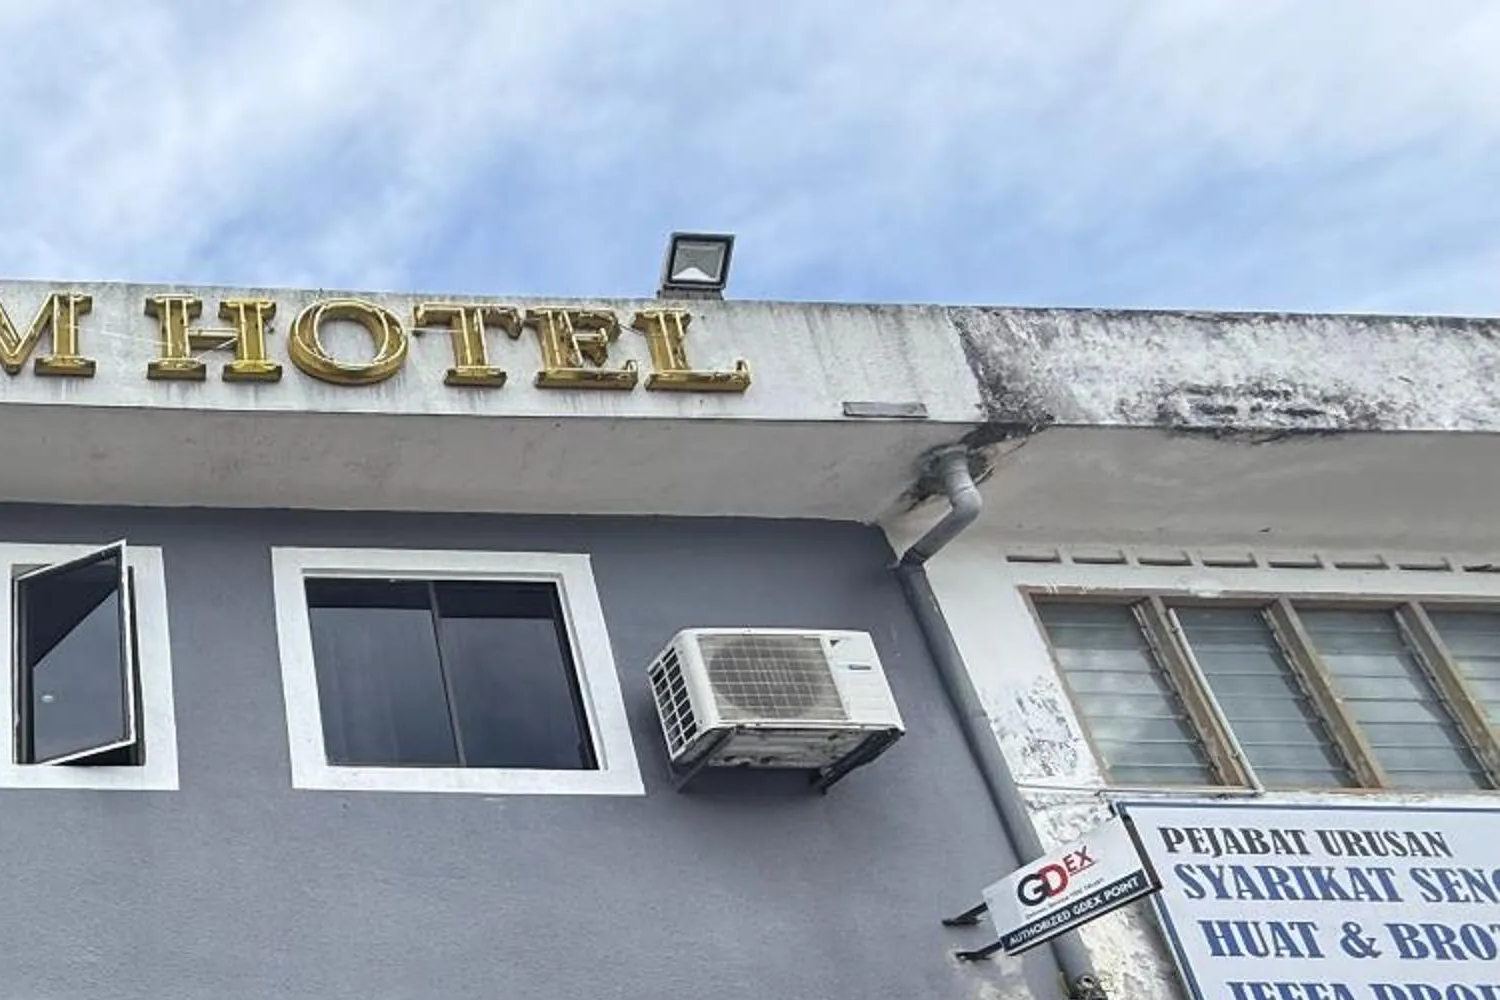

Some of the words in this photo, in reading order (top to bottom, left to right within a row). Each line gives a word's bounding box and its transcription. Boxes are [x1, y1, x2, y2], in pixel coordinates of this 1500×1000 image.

[144, 293, 751, 392] HOTEL
[1158, 826, 1311, 858] PEJABAT
[1314, 829, 1454, 858] URUSAN
[1174, 863, 1405, 903] SYARIKAT
[1409, 867, 1500, 904] SEN
[1008, 908, 1071, 946] AUTHORIZED
[1072, 893, 1104, 917] GDEX
[1103, 877, 1140, 901] POINT
[1197, 919, 1325, 959] HUAT
[1339, 920, 1383, 960] &
